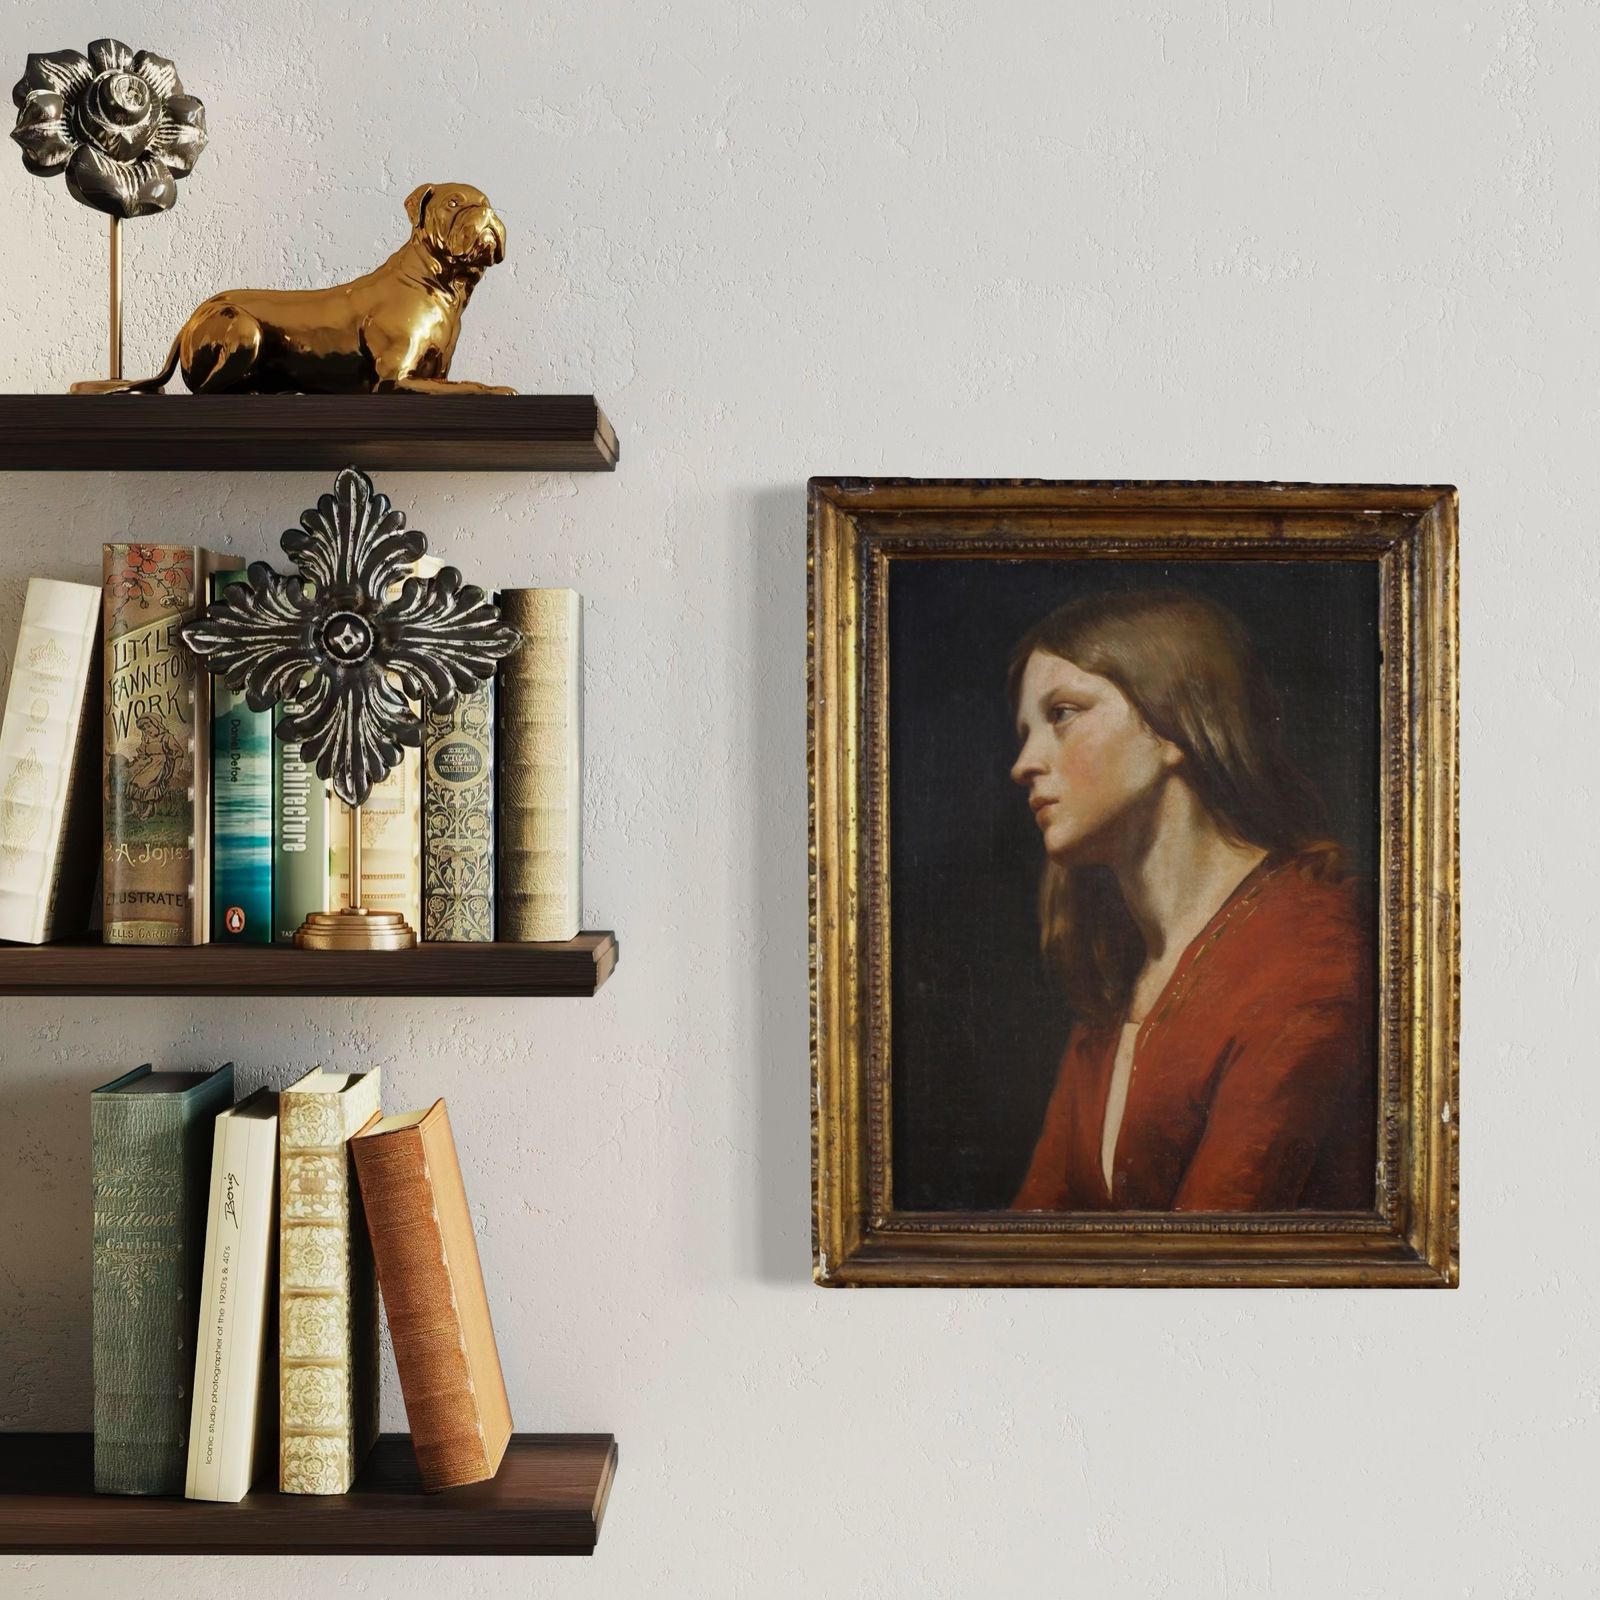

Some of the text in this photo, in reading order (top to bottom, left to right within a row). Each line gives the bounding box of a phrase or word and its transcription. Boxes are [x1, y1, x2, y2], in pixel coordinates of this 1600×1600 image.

[113, 624, 176, 674] LITTLE
[112, 684, 187, 741] WORK
[230, 719, 241, 783] Daniel Defoe
[94, 1211, 176, 1227] Wedlock
[224, 1172, 240, 1230] Boris
[217, 1307, 225, 1324] the
[217, 1325, 224, 1336] of
[211, 1338, 223, 1403] photographer
[208, 1405, 216, 1434] studio
[205, 1436, 214, 1465] Iconic
